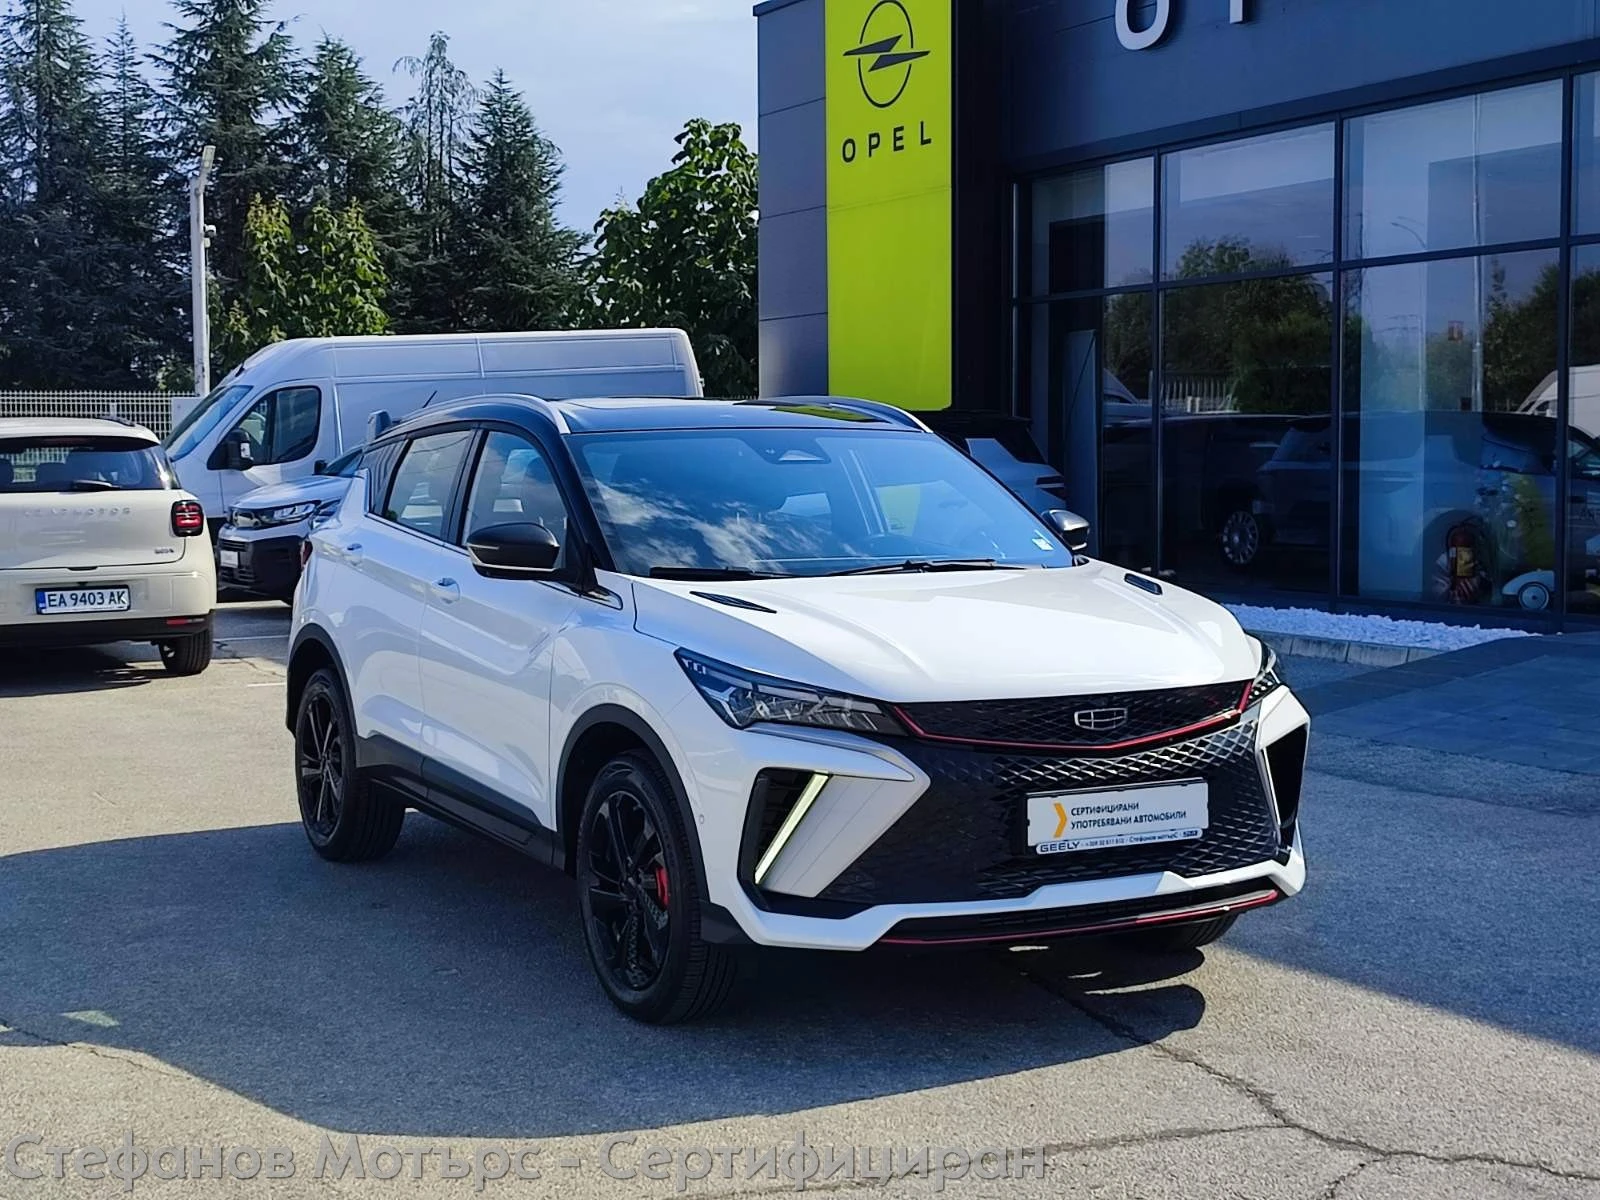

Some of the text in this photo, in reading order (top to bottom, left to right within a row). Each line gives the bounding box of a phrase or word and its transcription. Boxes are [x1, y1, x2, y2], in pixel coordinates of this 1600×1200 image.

[842, 120, 933, 163] OPEL
[48, 590, 126, 607] EA 9403 AK
[1071, 802, 1139, 817] СЕРТИФИЦИРАНИ
[1071, 810, 1187, 830] УПОТРЕБЯВАНИ АВТОМОБИЛИ
[1040, 841, 1080, 853] GEELY
